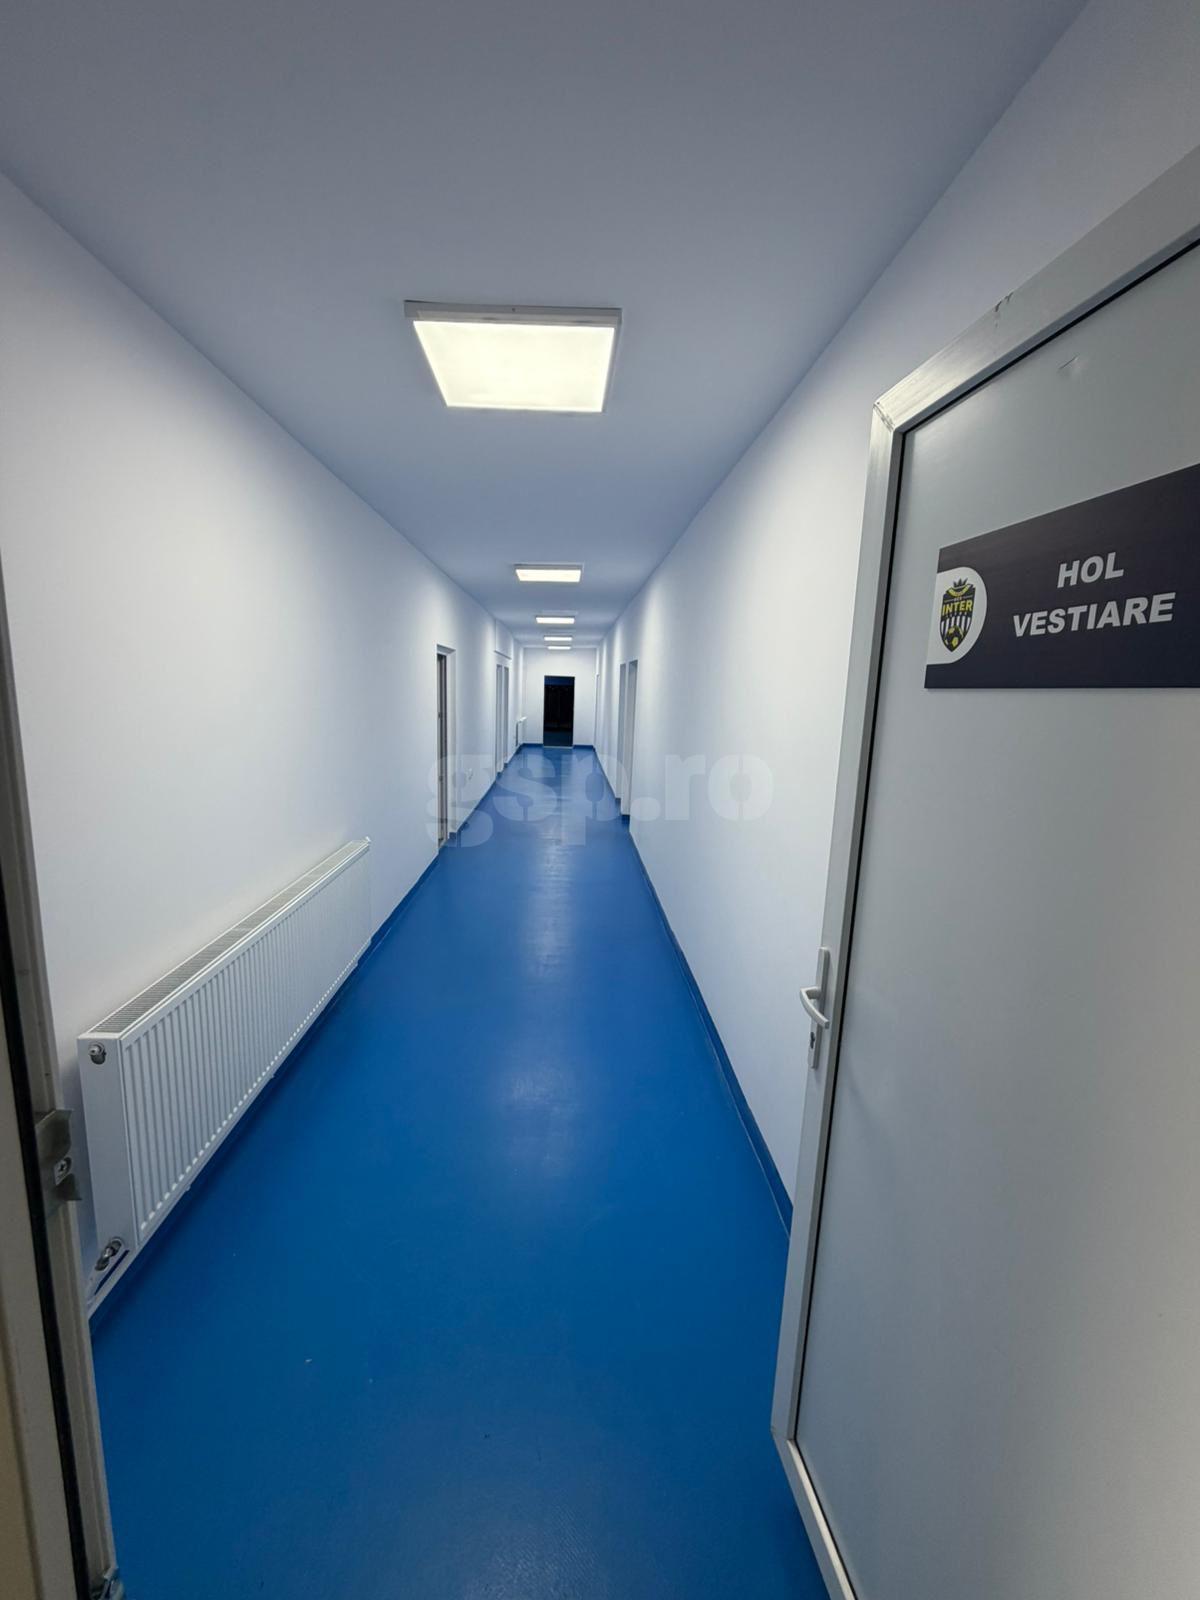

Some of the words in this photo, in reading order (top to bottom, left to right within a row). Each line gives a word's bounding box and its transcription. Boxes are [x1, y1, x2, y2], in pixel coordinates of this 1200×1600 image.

[1057, 551, 1124, 588] HOL
[942, 599, 973, 616] INTER
[1012, 591, 1176, 637] VESTIARE
